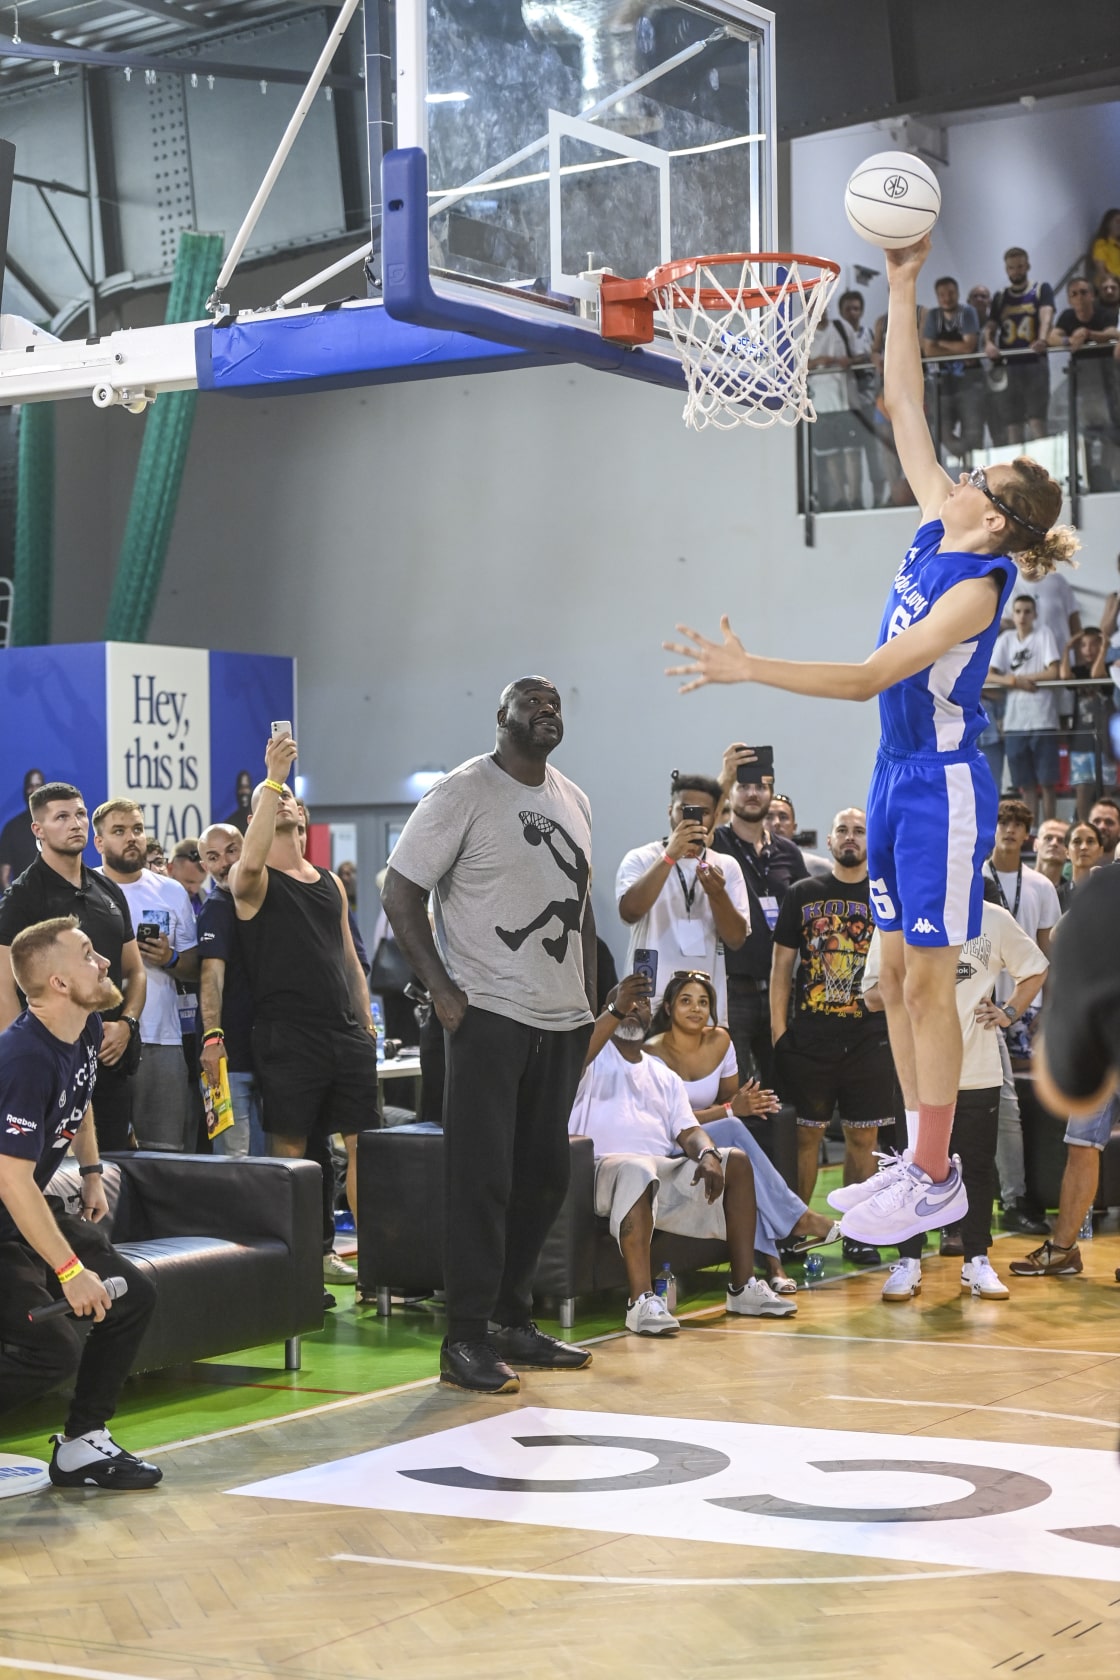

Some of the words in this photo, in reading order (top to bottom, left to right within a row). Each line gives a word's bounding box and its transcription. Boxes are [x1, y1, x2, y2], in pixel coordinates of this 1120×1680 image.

[132, 674, 190, 740] Hey,
[124, 736, 173, 791] this
[178, 741, 199, 791] is
[869, 877, 897, 920] 6
[6, 1113, 38, 1130] Reebok
